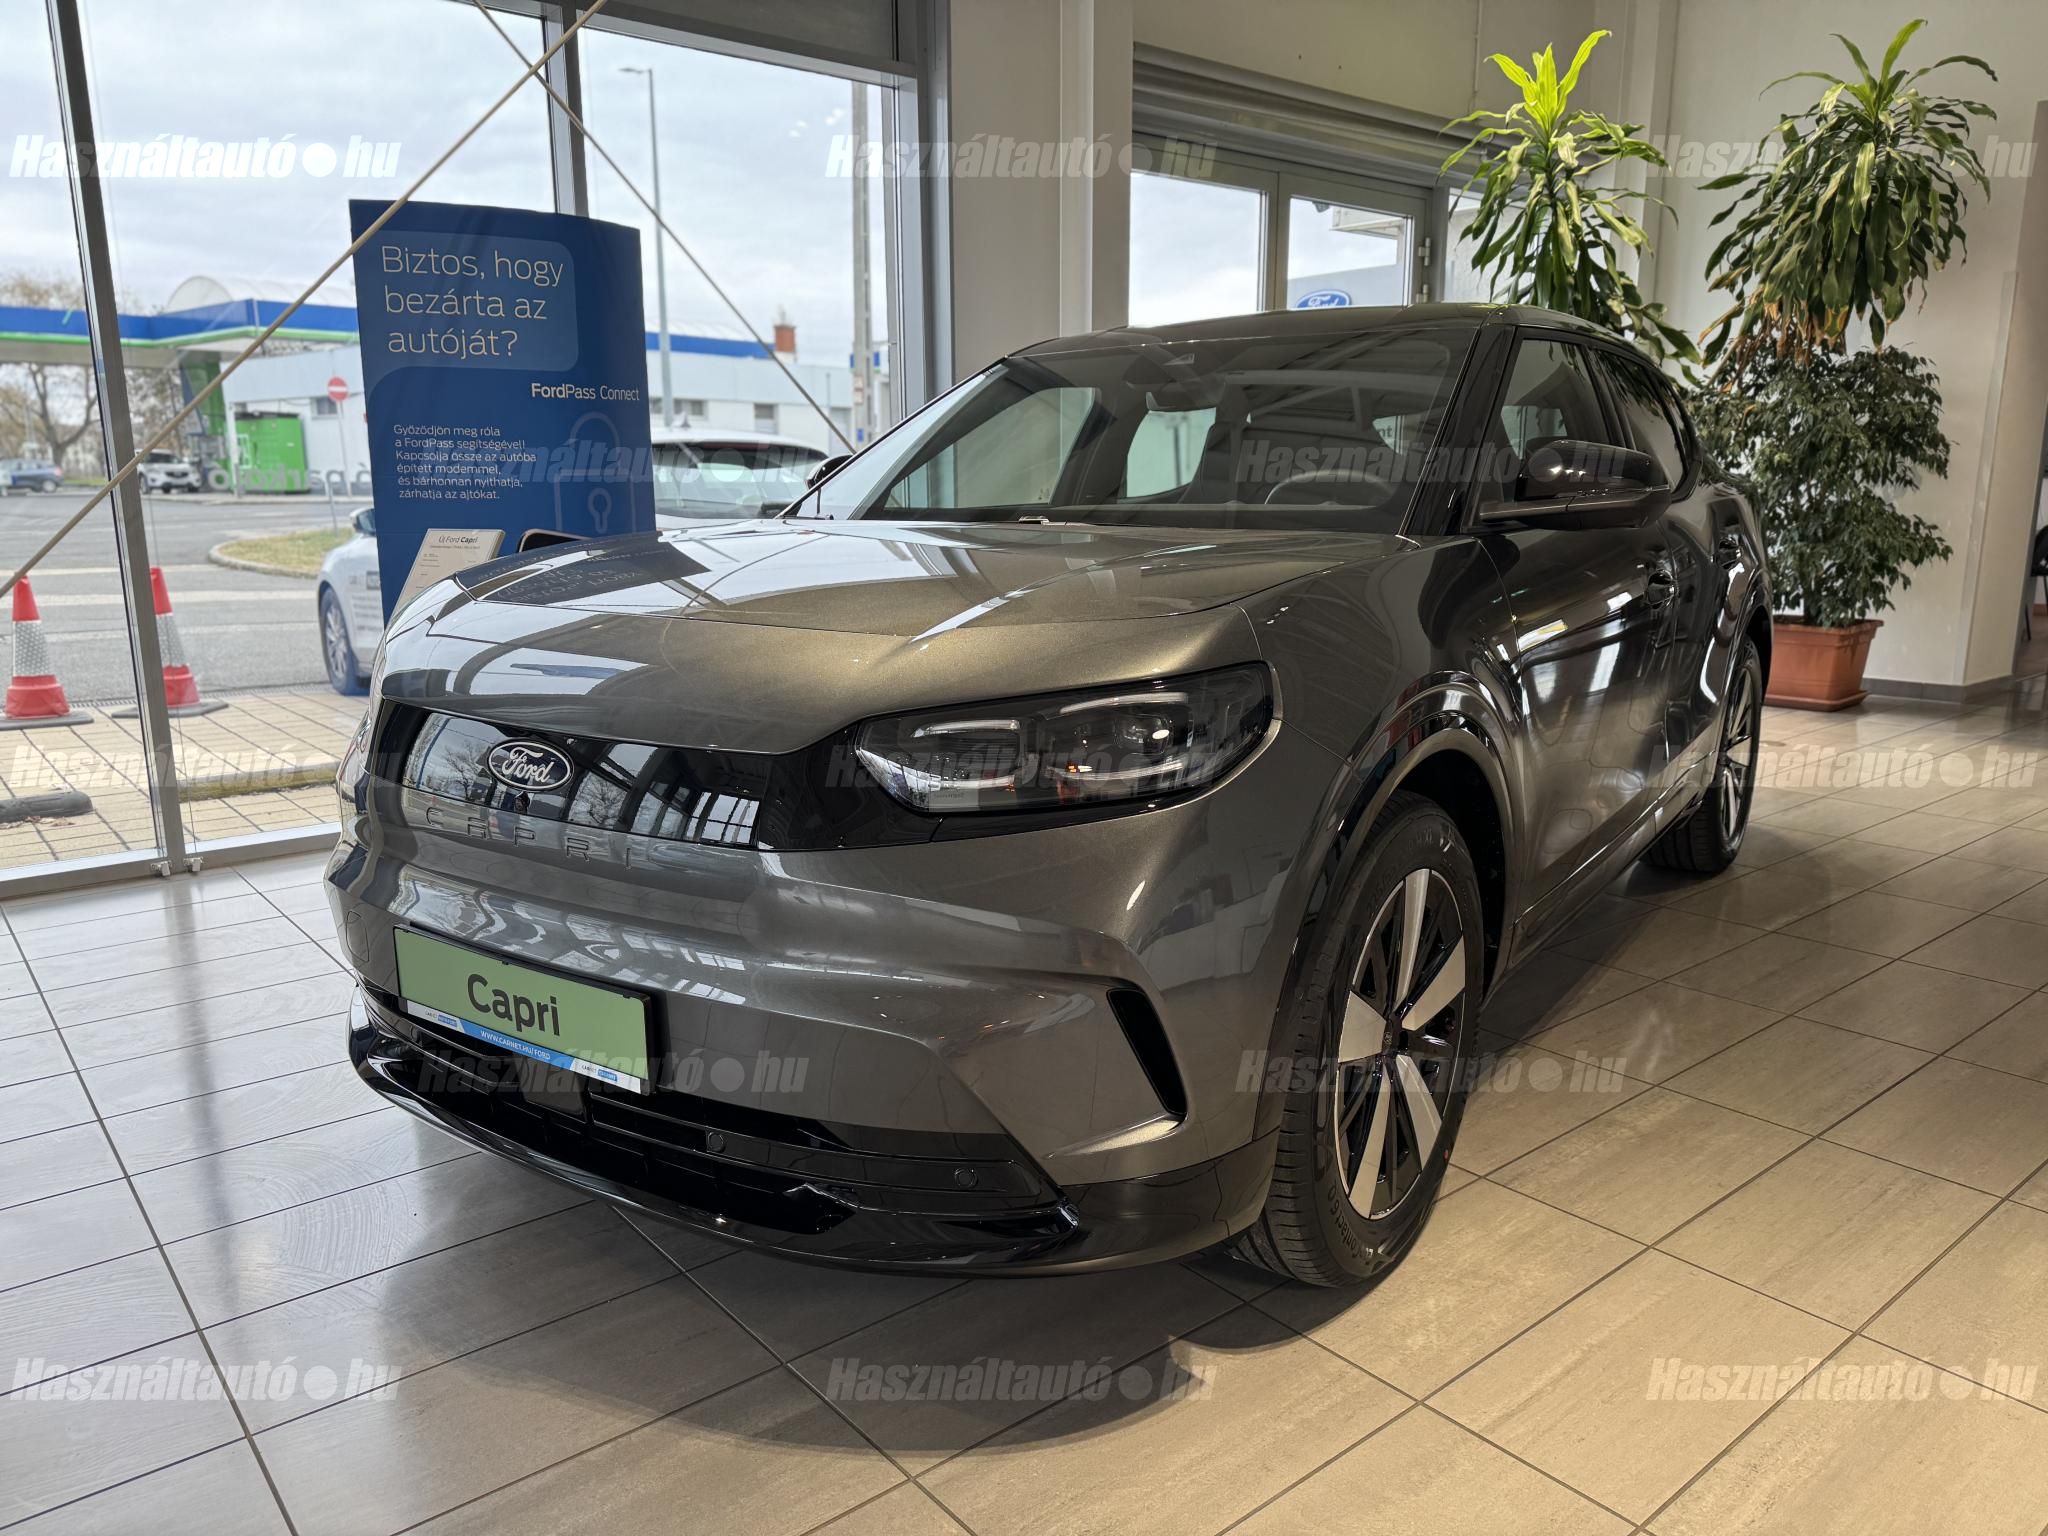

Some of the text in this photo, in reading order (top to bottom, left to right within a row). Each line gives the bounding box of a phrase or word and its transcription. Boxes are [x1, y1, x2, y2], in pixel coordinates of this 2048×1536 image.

[381, 245, 564, 288] Biztos, hogy
[384, 286, 547, 320] bezárta az
[388, 328, 518, 359] autóját?
[531, 382, 640, 401] FordPass Connect
[453, 427, 478, 437] meg
[480, 424, 501, 437] róla
[394, 439, 402, 447] a
[404, 437, 455, 448] FordPass
[395, 451, 449, 463] Kapcsolja
[484, 453, 497, 462] az
[499, 451, 537, 462] autóba
[398, 475, 411, 485] és
[412, 475, 472, 486] bárhonnan
[399, 488, 442, 500] zárhatja
[444, 490, 457, 499] az
[446, 535, 461, 543] Ford
[460, 536, 479, 545] Capri
[502, 746, 554, 786] Ford
[426, 806, 633, 871] CAPRI
[466, 973, 561, 1037] Capri
